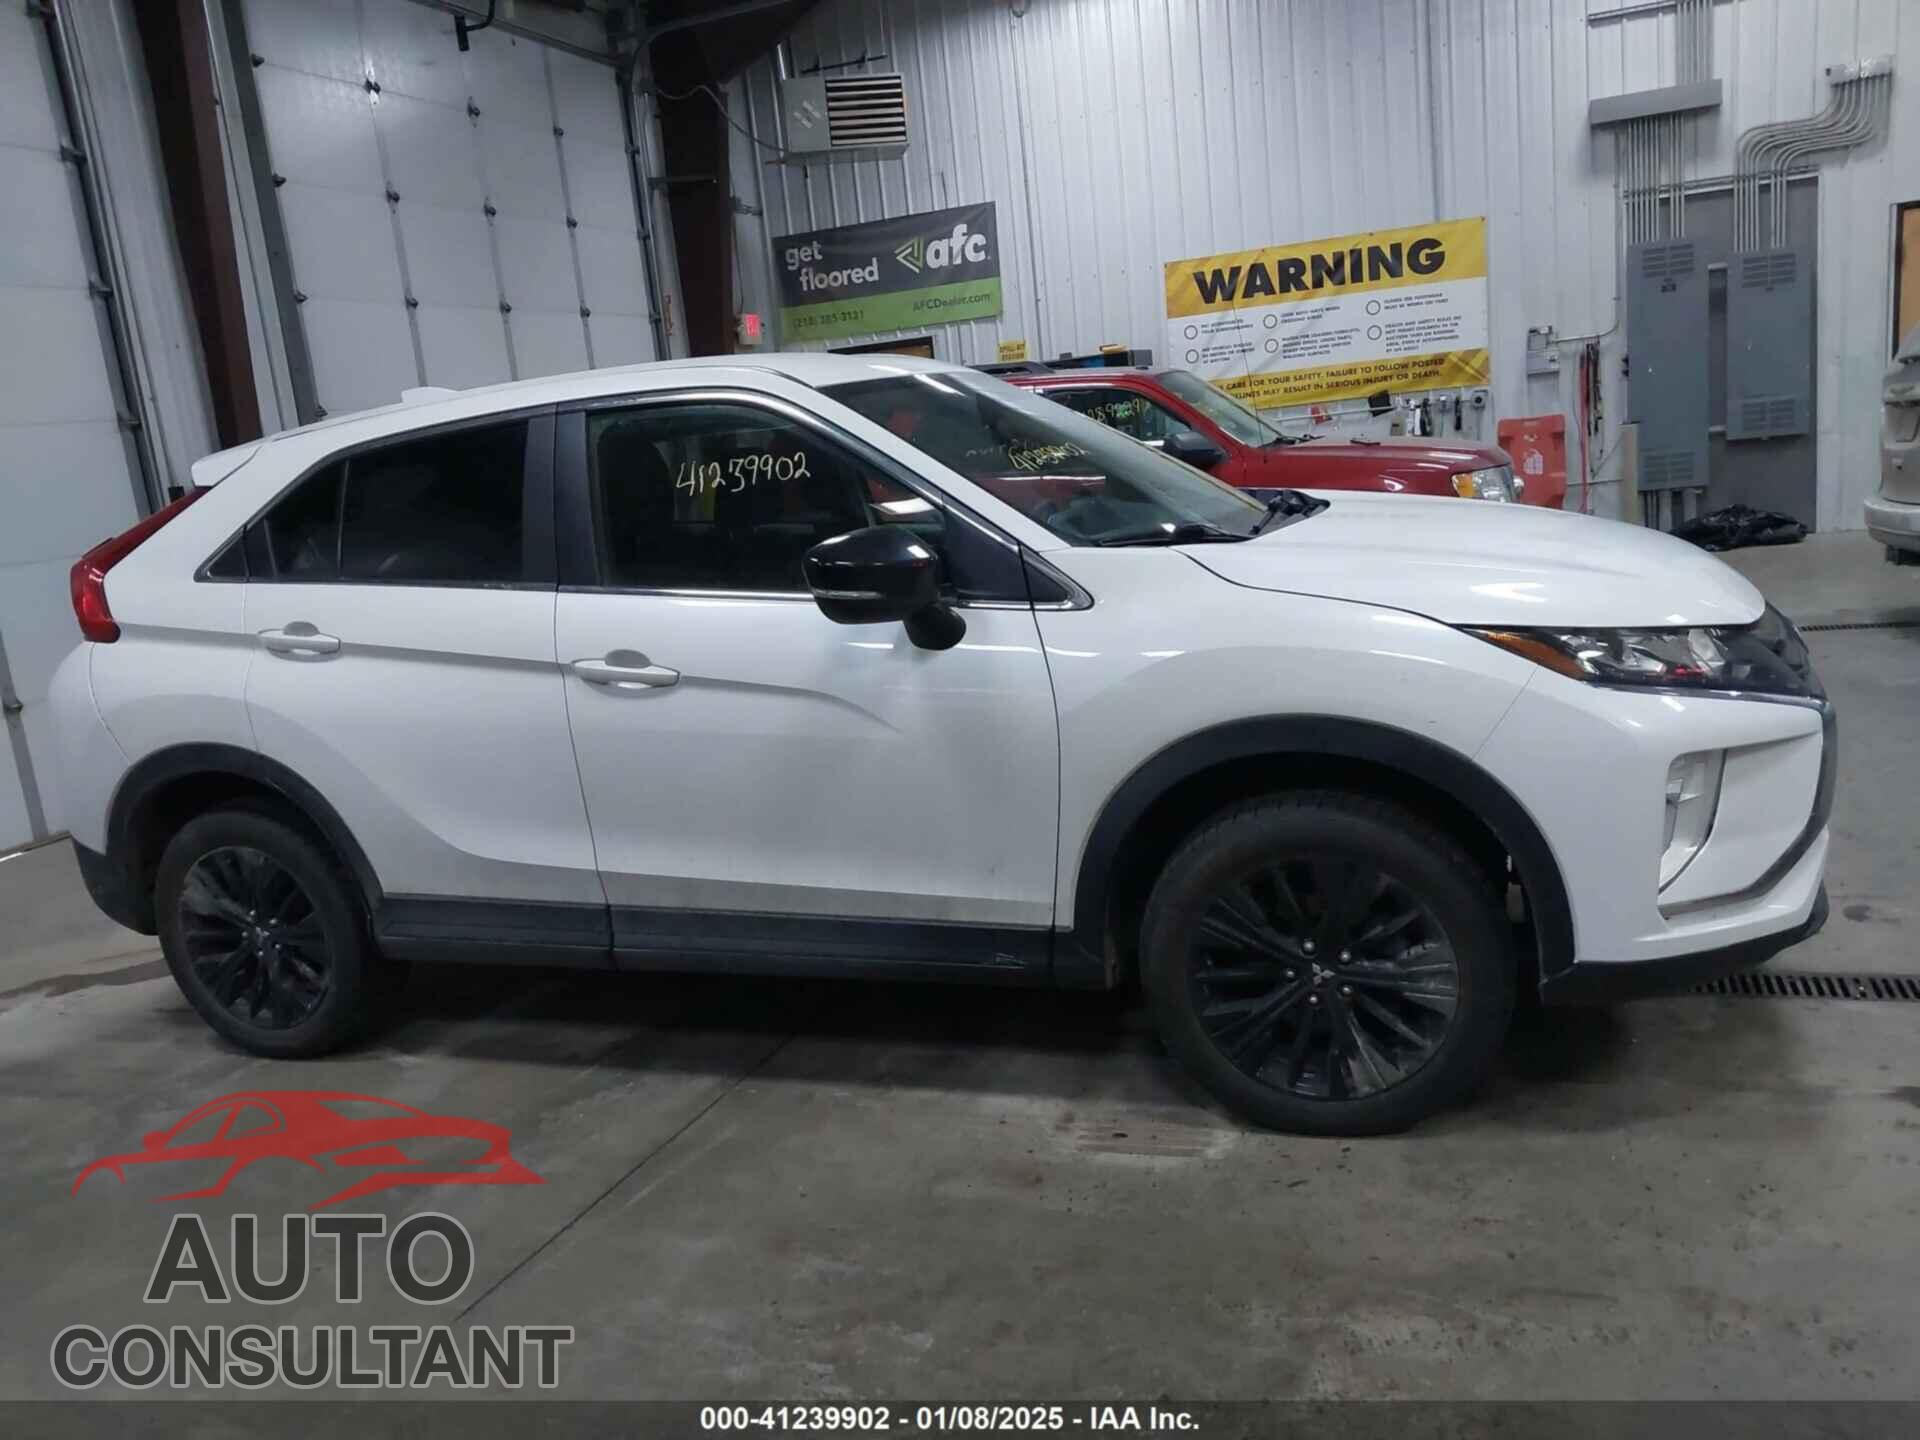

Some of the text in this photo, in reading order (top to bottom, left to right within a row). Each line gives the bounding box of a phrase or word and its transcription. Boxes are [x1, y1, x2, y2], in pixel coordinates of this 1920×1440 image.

[785, 241, 823, 270] get
[926, 223, 987, 269] afc
[800, 257, 879, 291] floored
[1193, 237, 1446, 305] WARNING
[1249, 379, 1265, 387] FOR
[1268, 376, 1290, 385] YOUR
[1326, 368, 1357, 377] FAILURE
[1360, 366, 1371, 374] TO
[1374, 362, 1409, 372] FOLLOW
[1412, 358, 1444, 368] POSTED
[1284, 384, 1311, 393] RESULT
[1313, 382, 1323, 390] IN
[1327, 379, 1361, 388] SERIOUS
[1363, 375, 1394, 384] INJURY
[676, 452, 811, 497] 41239902
